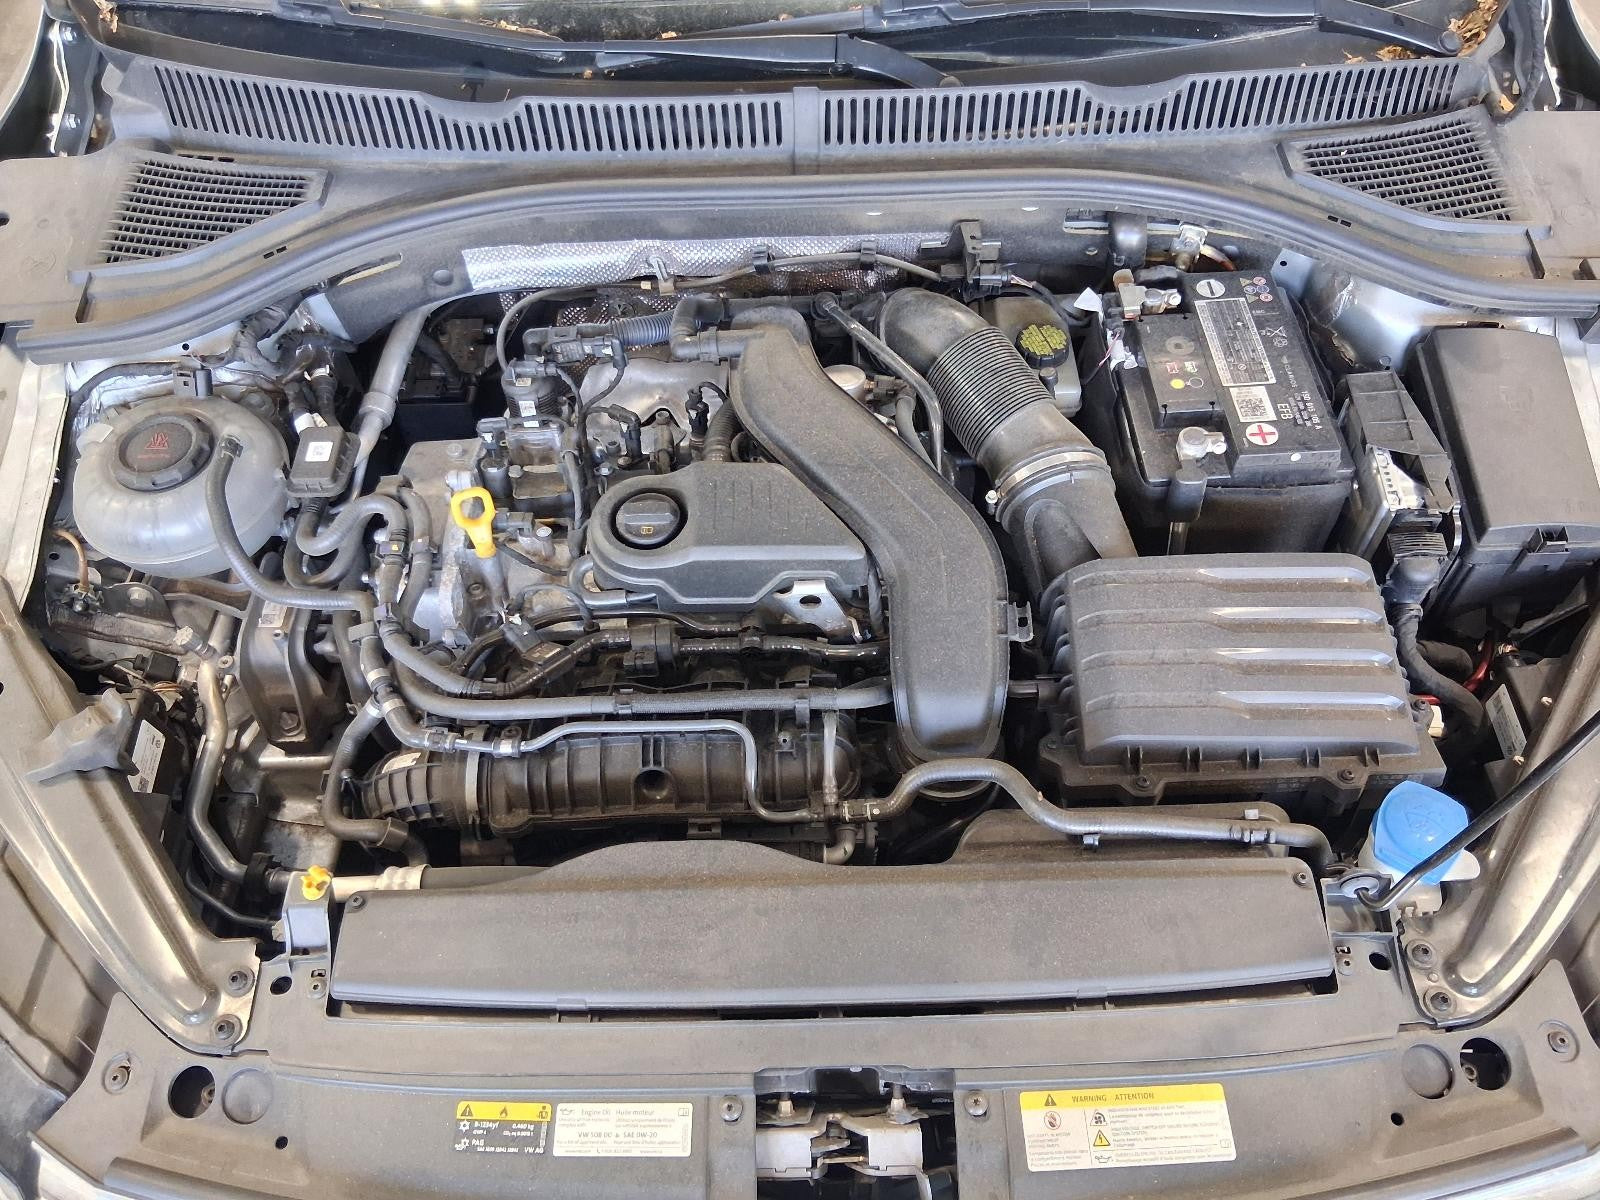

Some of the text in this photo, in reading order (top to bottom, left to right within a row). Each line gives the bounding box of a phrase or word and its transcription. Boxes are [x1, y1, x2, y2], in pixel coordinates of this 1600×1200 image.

[1277, 403, 1293, 420] EFB
[1071, 1092, 1155, 1103] WARNING ATTENTION
[581, 1108, 601, 1117] Engine
[615, 1108, 632, 1116] Huile
